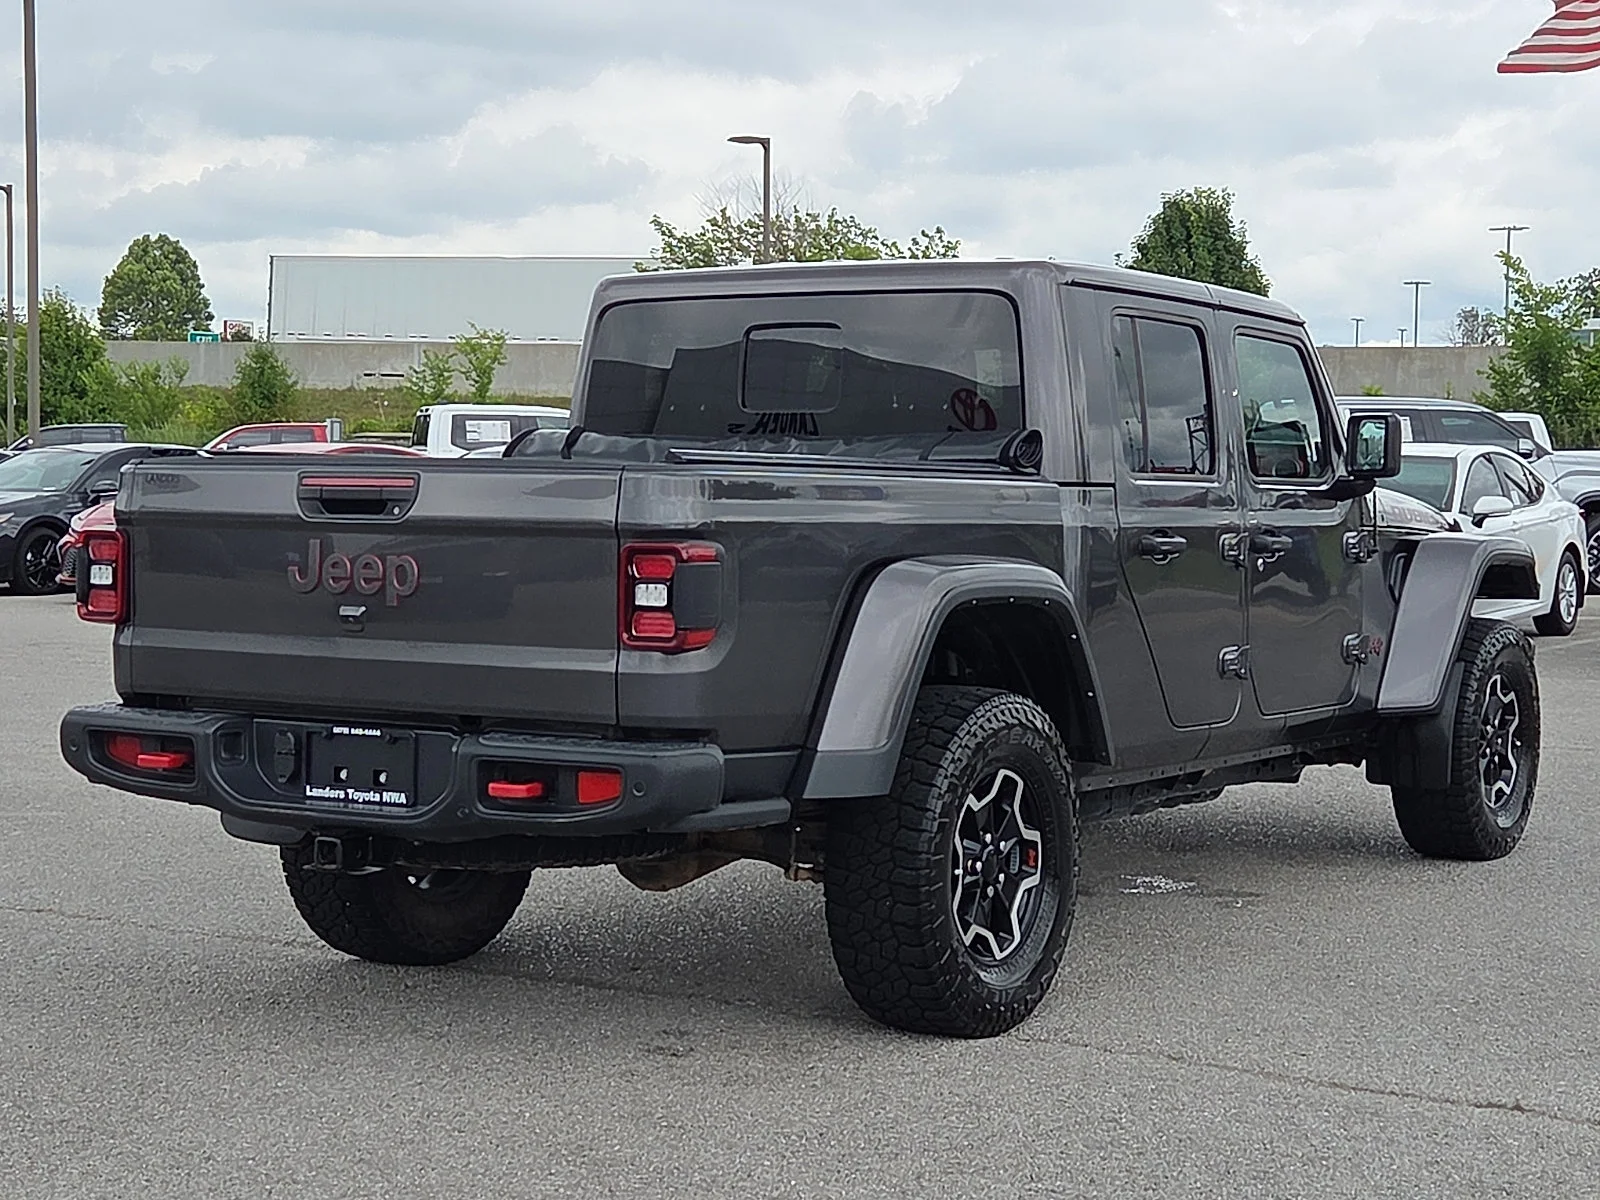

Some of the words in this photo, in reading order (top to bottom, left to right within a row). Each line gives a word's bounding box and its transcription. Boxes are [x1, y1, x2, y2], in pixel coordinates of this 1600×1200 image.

[287, 538, 419, 607] Jeep
[305, 784, 346, 799] Landers
[346, 788, 381, 803] Toyota
[382, 791, 408, 805] NWA
